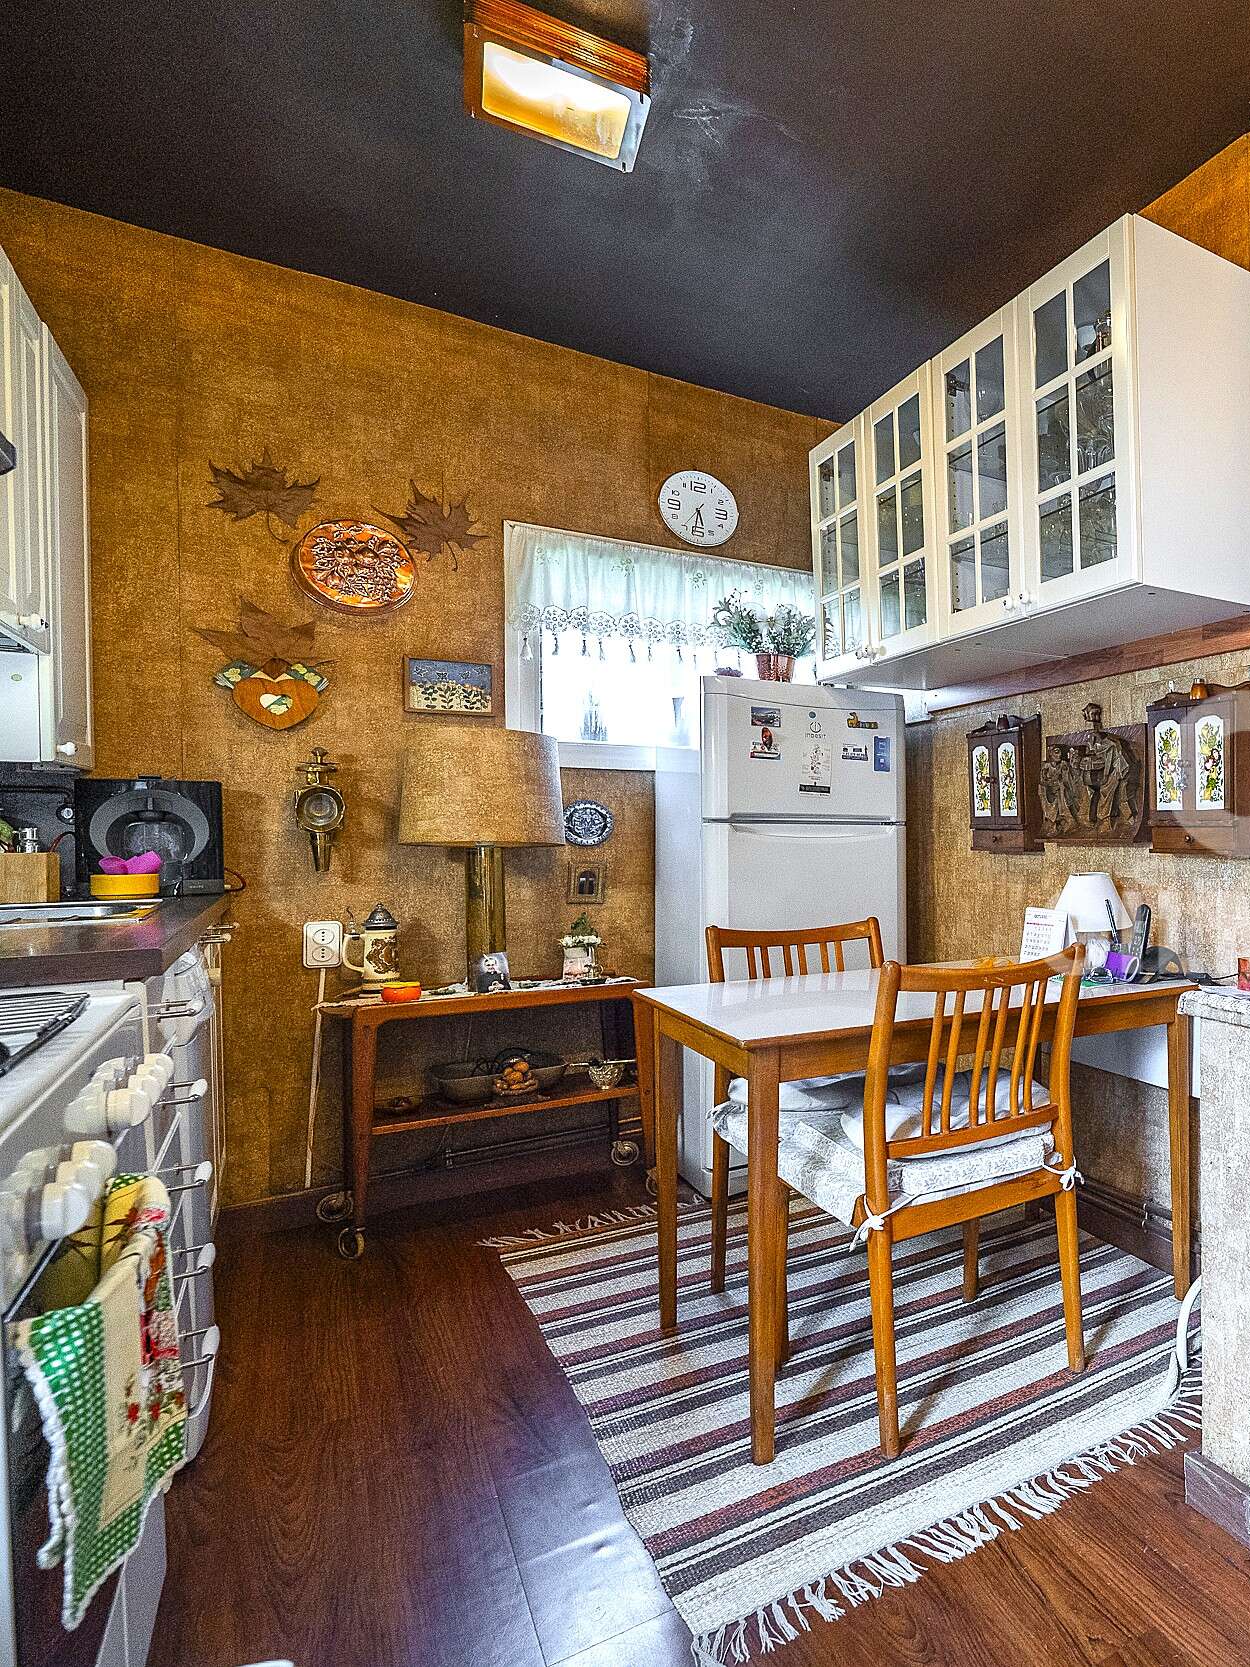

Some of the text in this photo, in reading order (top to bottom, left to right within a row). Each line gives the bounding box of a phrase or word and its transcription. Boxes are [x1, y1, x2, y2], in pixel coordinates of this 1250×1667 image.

[690, 480, 707, 494] 12
[667, 498, 681, 511] 9
[715, 508, 728, 521] 3
[691, 525, 705, 538] 6
